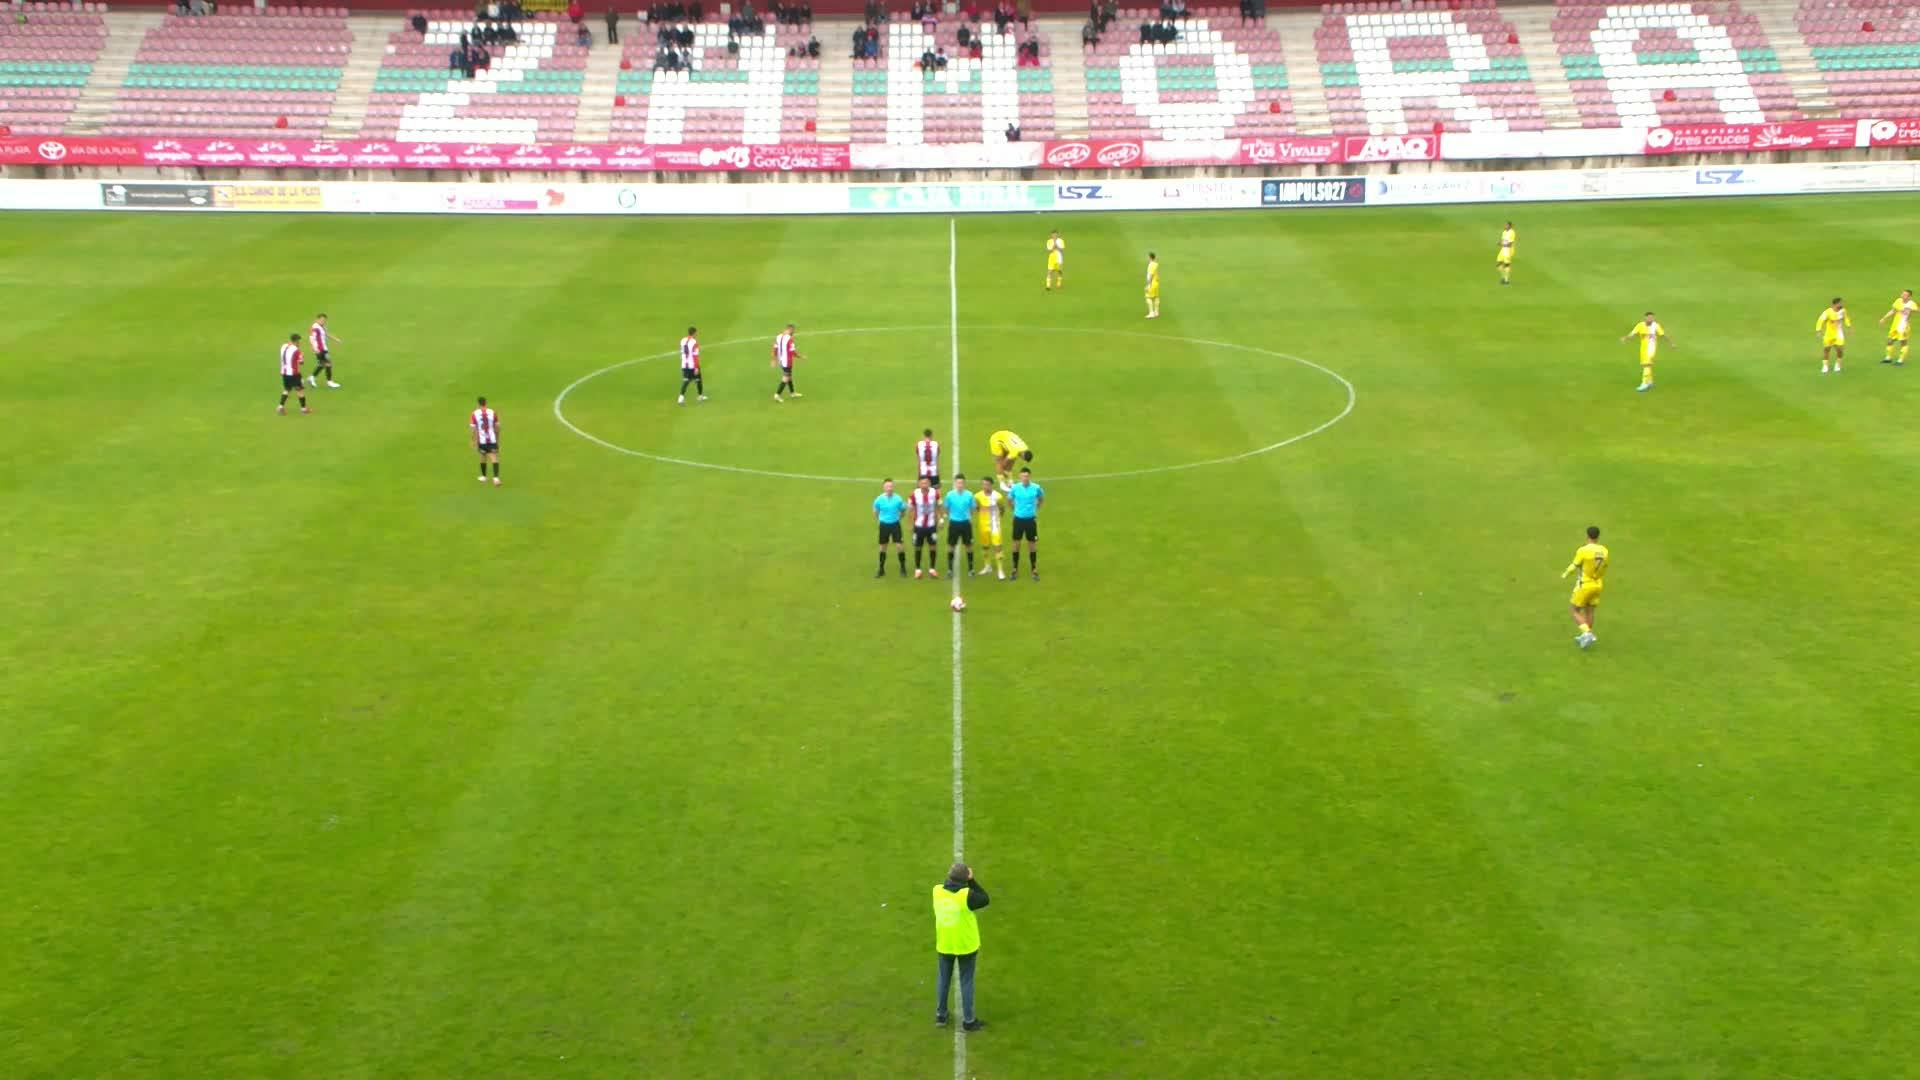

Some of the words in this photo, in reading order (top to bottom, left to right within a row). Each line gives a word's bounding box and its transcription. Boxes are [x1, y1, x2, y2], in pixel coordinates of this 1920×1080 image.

[396, 3, 1766, 143] ZAMORA
[1674, 136, 1701, 146] tres
[1704, 135, 1750, 145] cruces
[1695, 169, 1745, 184] LSZ
[1058, 186, 1103, 199] LSZ
[1279, 181, 1347, 202] IMPULSO27
